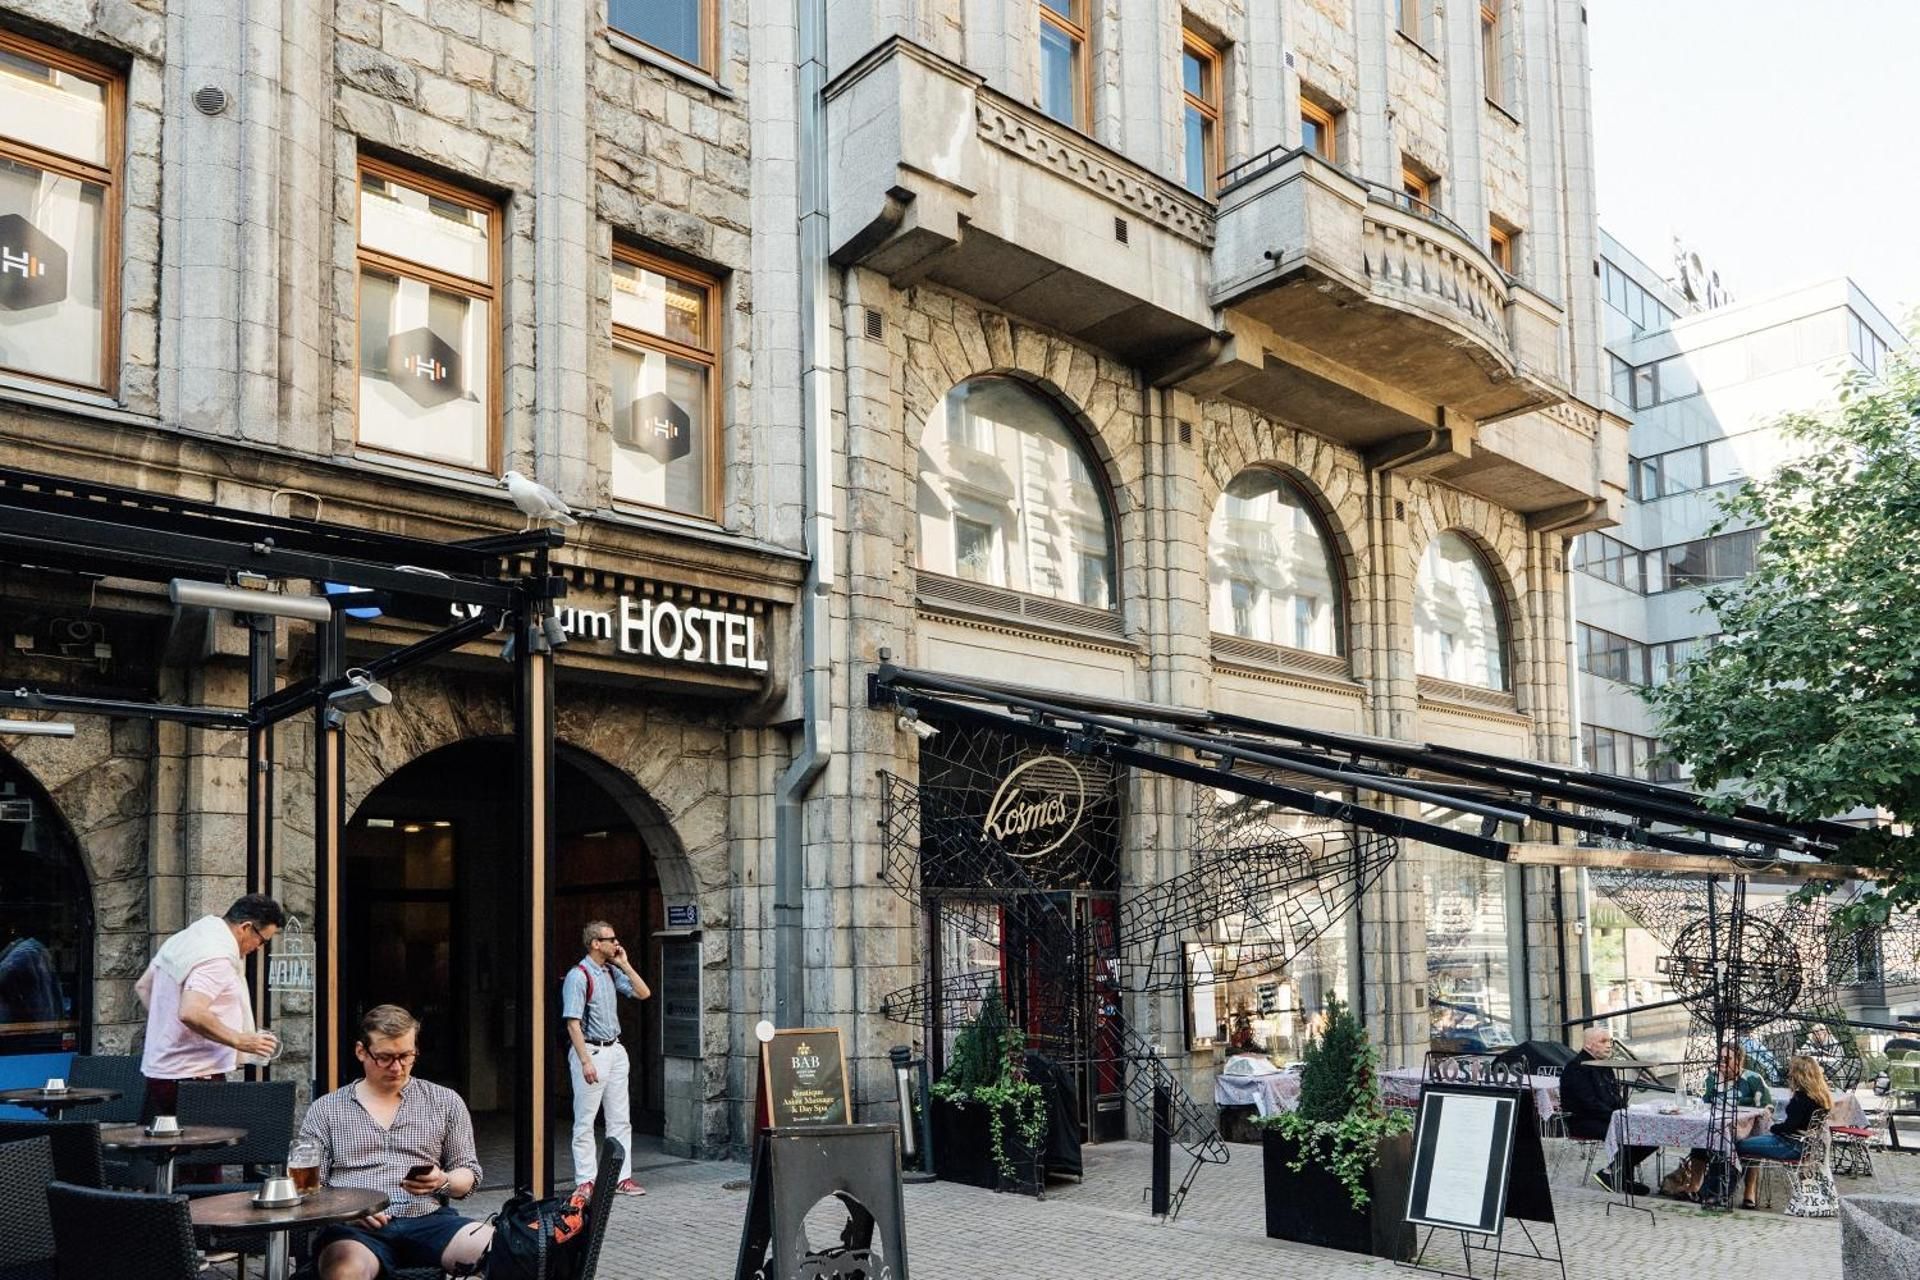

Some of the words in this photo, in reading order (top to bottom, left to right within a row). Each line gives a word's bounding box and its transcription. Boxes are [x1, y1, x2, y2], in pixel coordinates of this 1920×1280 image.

[553, 604, 612, 639] um
[620, 595, 768, 671] HOSTEL
[982, 788, 1066, 841] Kosmos
[791, 1055, 820, 1069] BAB
[1430, 1056, 1525, 1087] KOSMOS
[799, 1105, 813, 1115] Day
[813, 1104, 828, 1113] Spa
